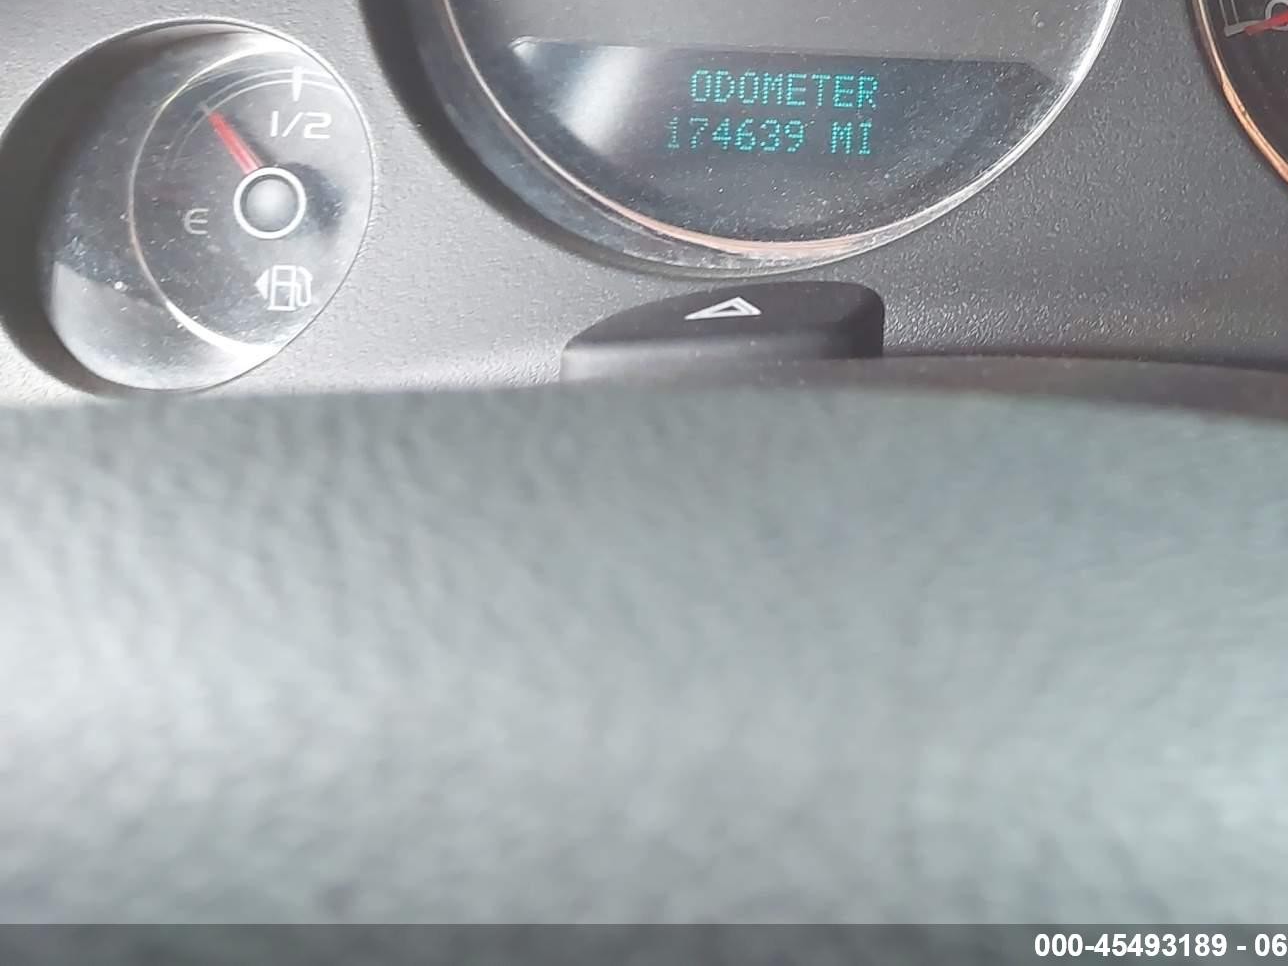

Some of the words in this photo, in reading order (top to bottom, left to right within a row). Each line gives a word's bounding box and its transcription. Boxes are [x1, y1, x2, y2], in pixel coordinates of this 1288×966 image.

[690, 69, 878, 109] ODOMETER
[270, 111, 332, 139] 1/2
[666, 116, 805, 152] 174639
[831, 120, 872, 155] MI
